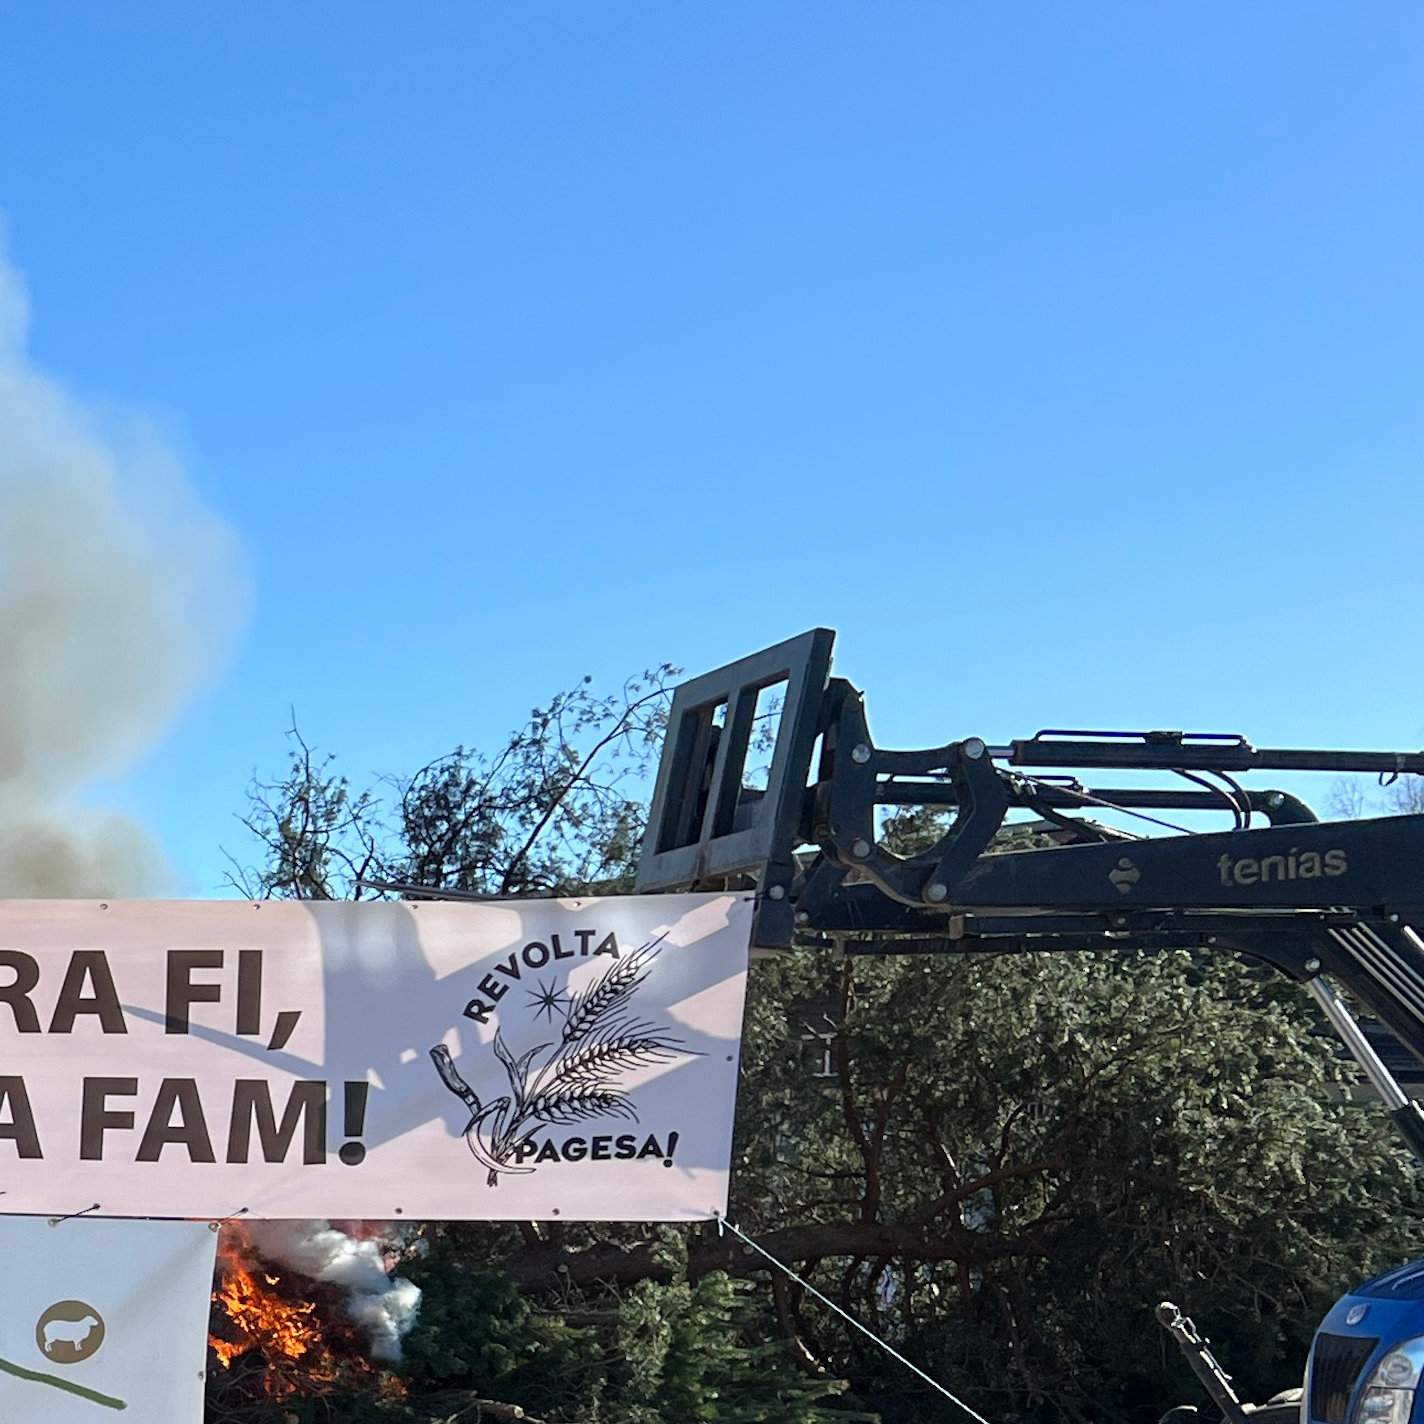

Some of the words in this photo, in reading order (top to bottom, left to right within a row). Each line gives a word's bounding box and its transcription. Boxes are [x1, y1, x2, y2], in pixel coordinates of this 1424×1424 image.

[165, 949, 302, 1051] FI,
[463, 929, 620, 1025] REVOLTA
[79, 1076, 370, 1166] FAM!
[515, 1131, 679, 1168] PAGESA!
